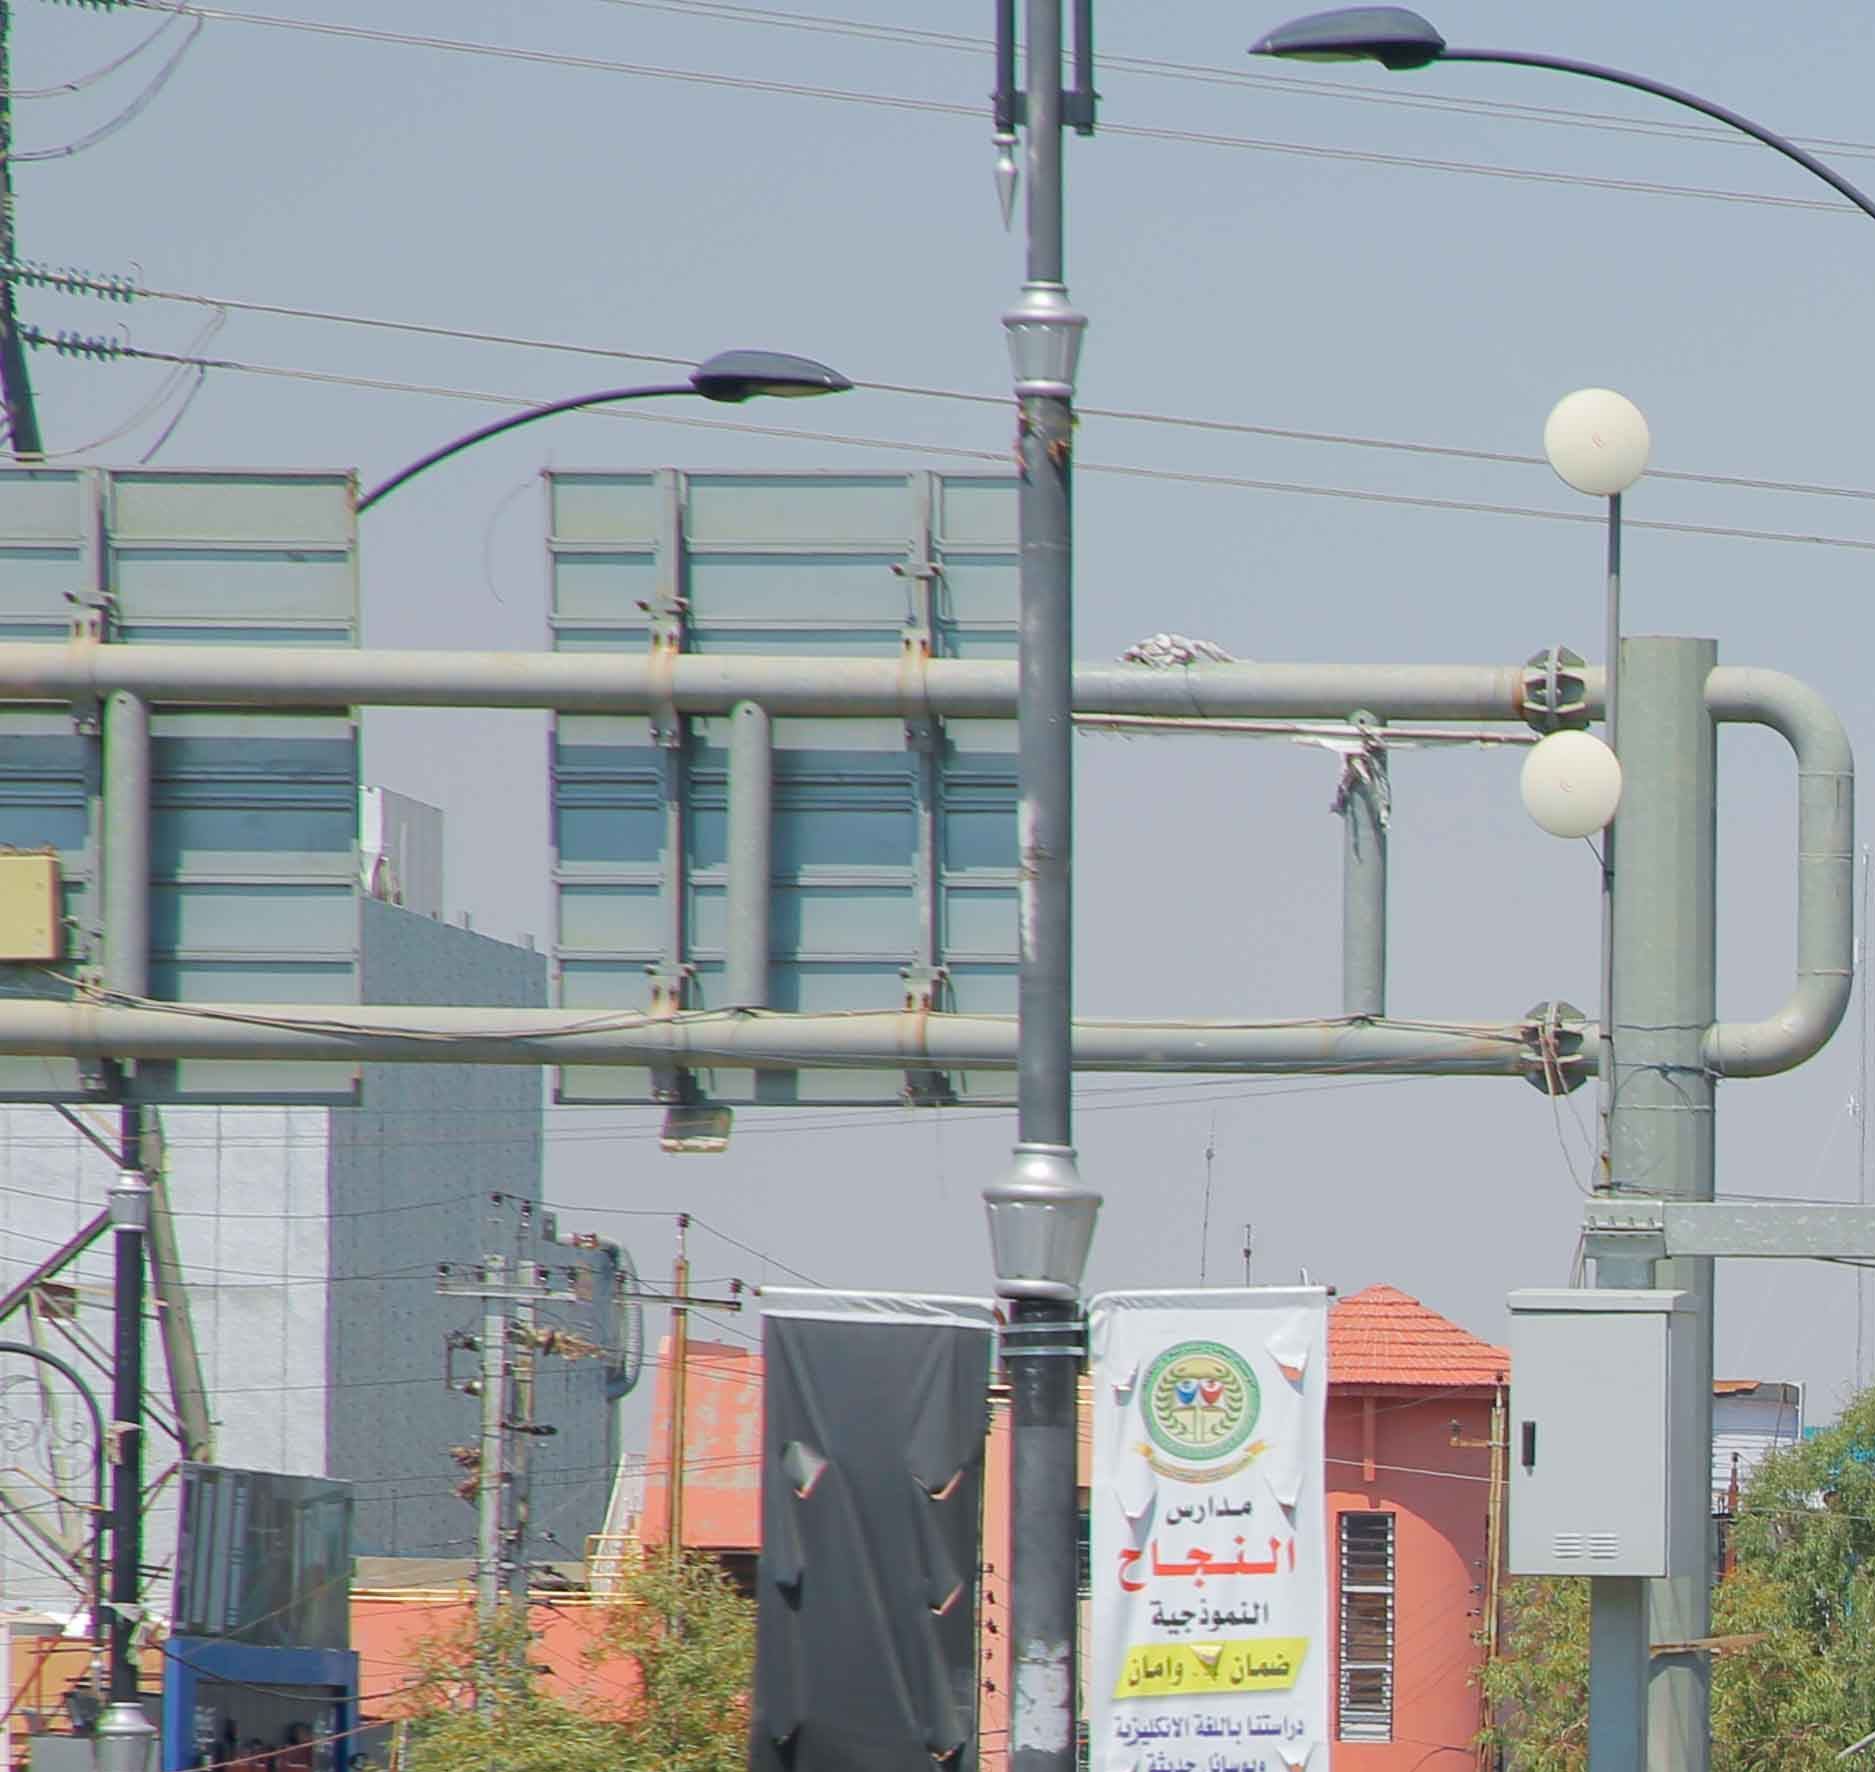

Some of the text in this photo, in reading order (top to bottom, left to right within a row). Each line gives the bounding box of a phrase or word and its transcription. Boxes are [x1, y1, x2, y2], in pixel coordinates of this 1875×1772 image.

[1166, 1498, 1252, 1525] مدارس
[1116, 1535, 1296, 1591] النجاح
[1152, 1598, 1270, 1640] النموذجية
[1230, 1648, 1291, 1684] ضمان
[1195, 1712, 1242, 1743] باللغة
